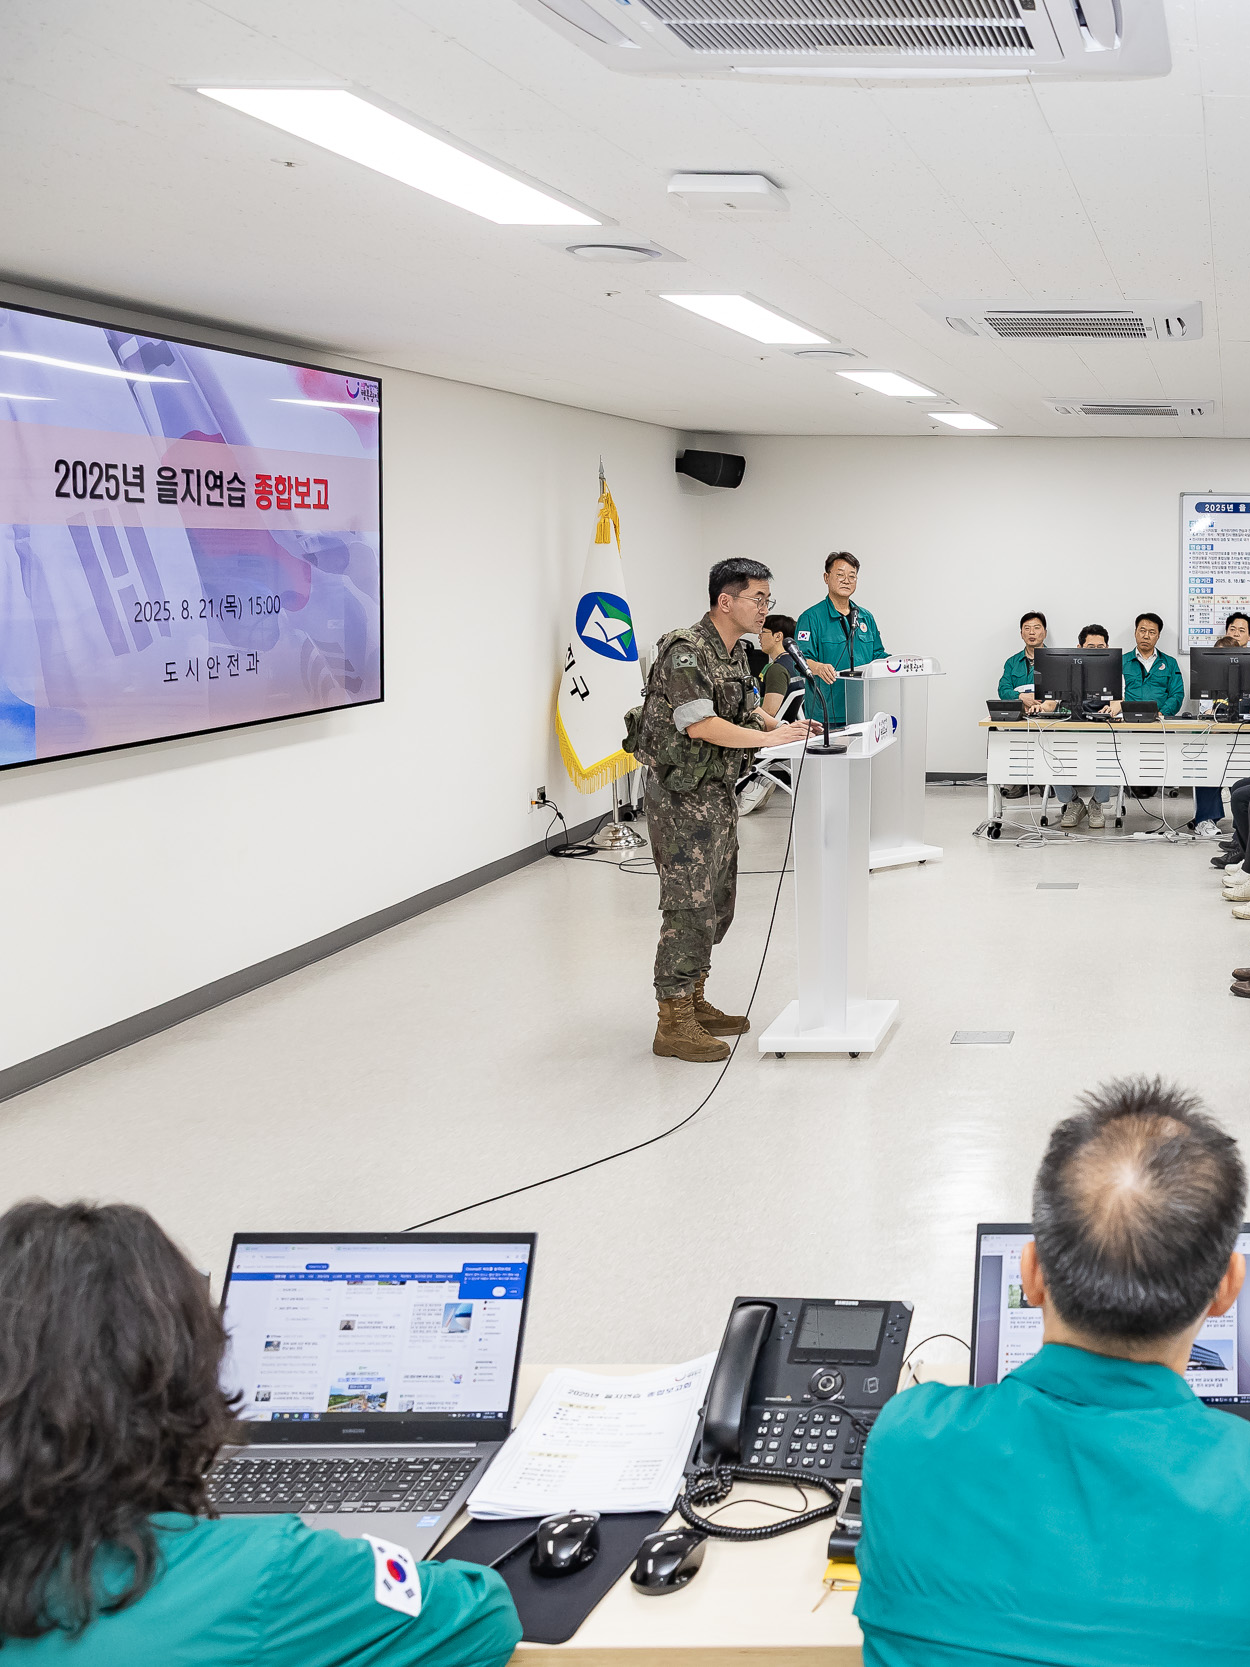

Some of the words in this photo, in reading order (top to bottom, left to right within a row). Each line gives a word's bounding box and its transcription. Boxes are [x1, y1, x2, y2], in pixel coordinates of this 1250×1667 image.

[54, 459, 145, 503] 2025년
[155, 466, 247, 508] 을지연습
[254, 473, 329, 510] 종합보고
[1205, 504, 1233, 512] 2025년
[134, 600, 175, 624] 2025.
[181, 599, 193, 619] 8.
[199, 594, 243, 619] 21.(목)
[248, 595, 281, 615] 15:00
